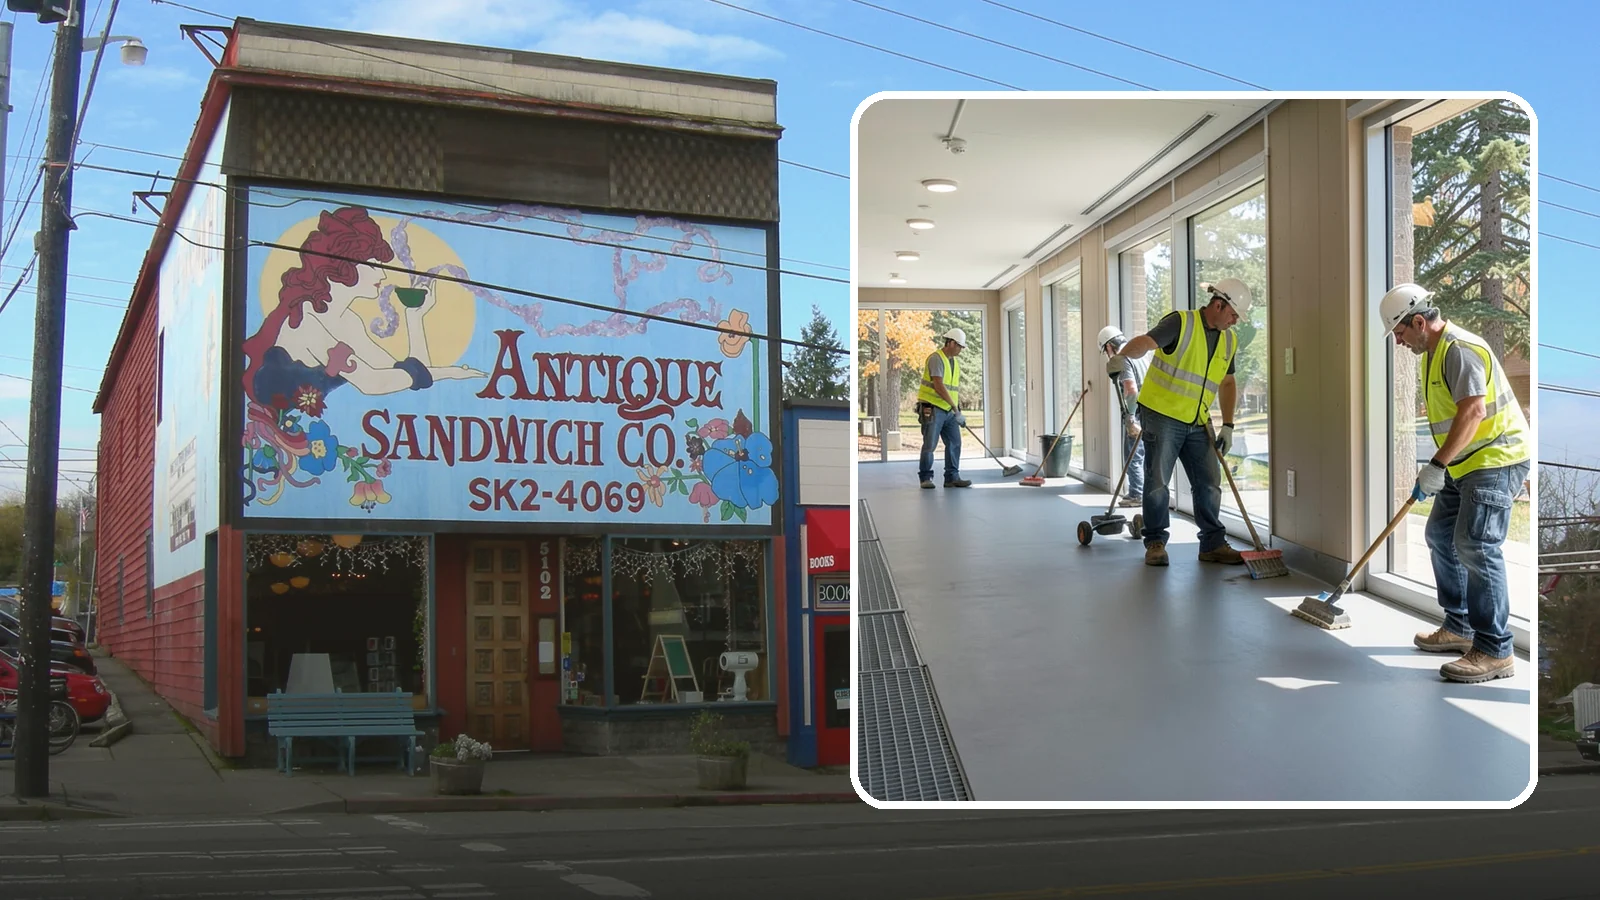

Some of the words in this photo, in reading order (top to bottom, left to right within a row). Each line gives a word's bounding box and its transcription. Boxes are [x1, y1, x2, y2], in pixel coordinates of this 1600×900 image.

[476, 329, 723, 421] ANTIQUE
[361, 409, 605, 467] SANDWICH
[617, 422, 685, 469] CO.
[468, 477, 646, 512] SK2-4069
[540, 542, 551, 599] 5102
[809, 555, 835, 569] BOOKS
